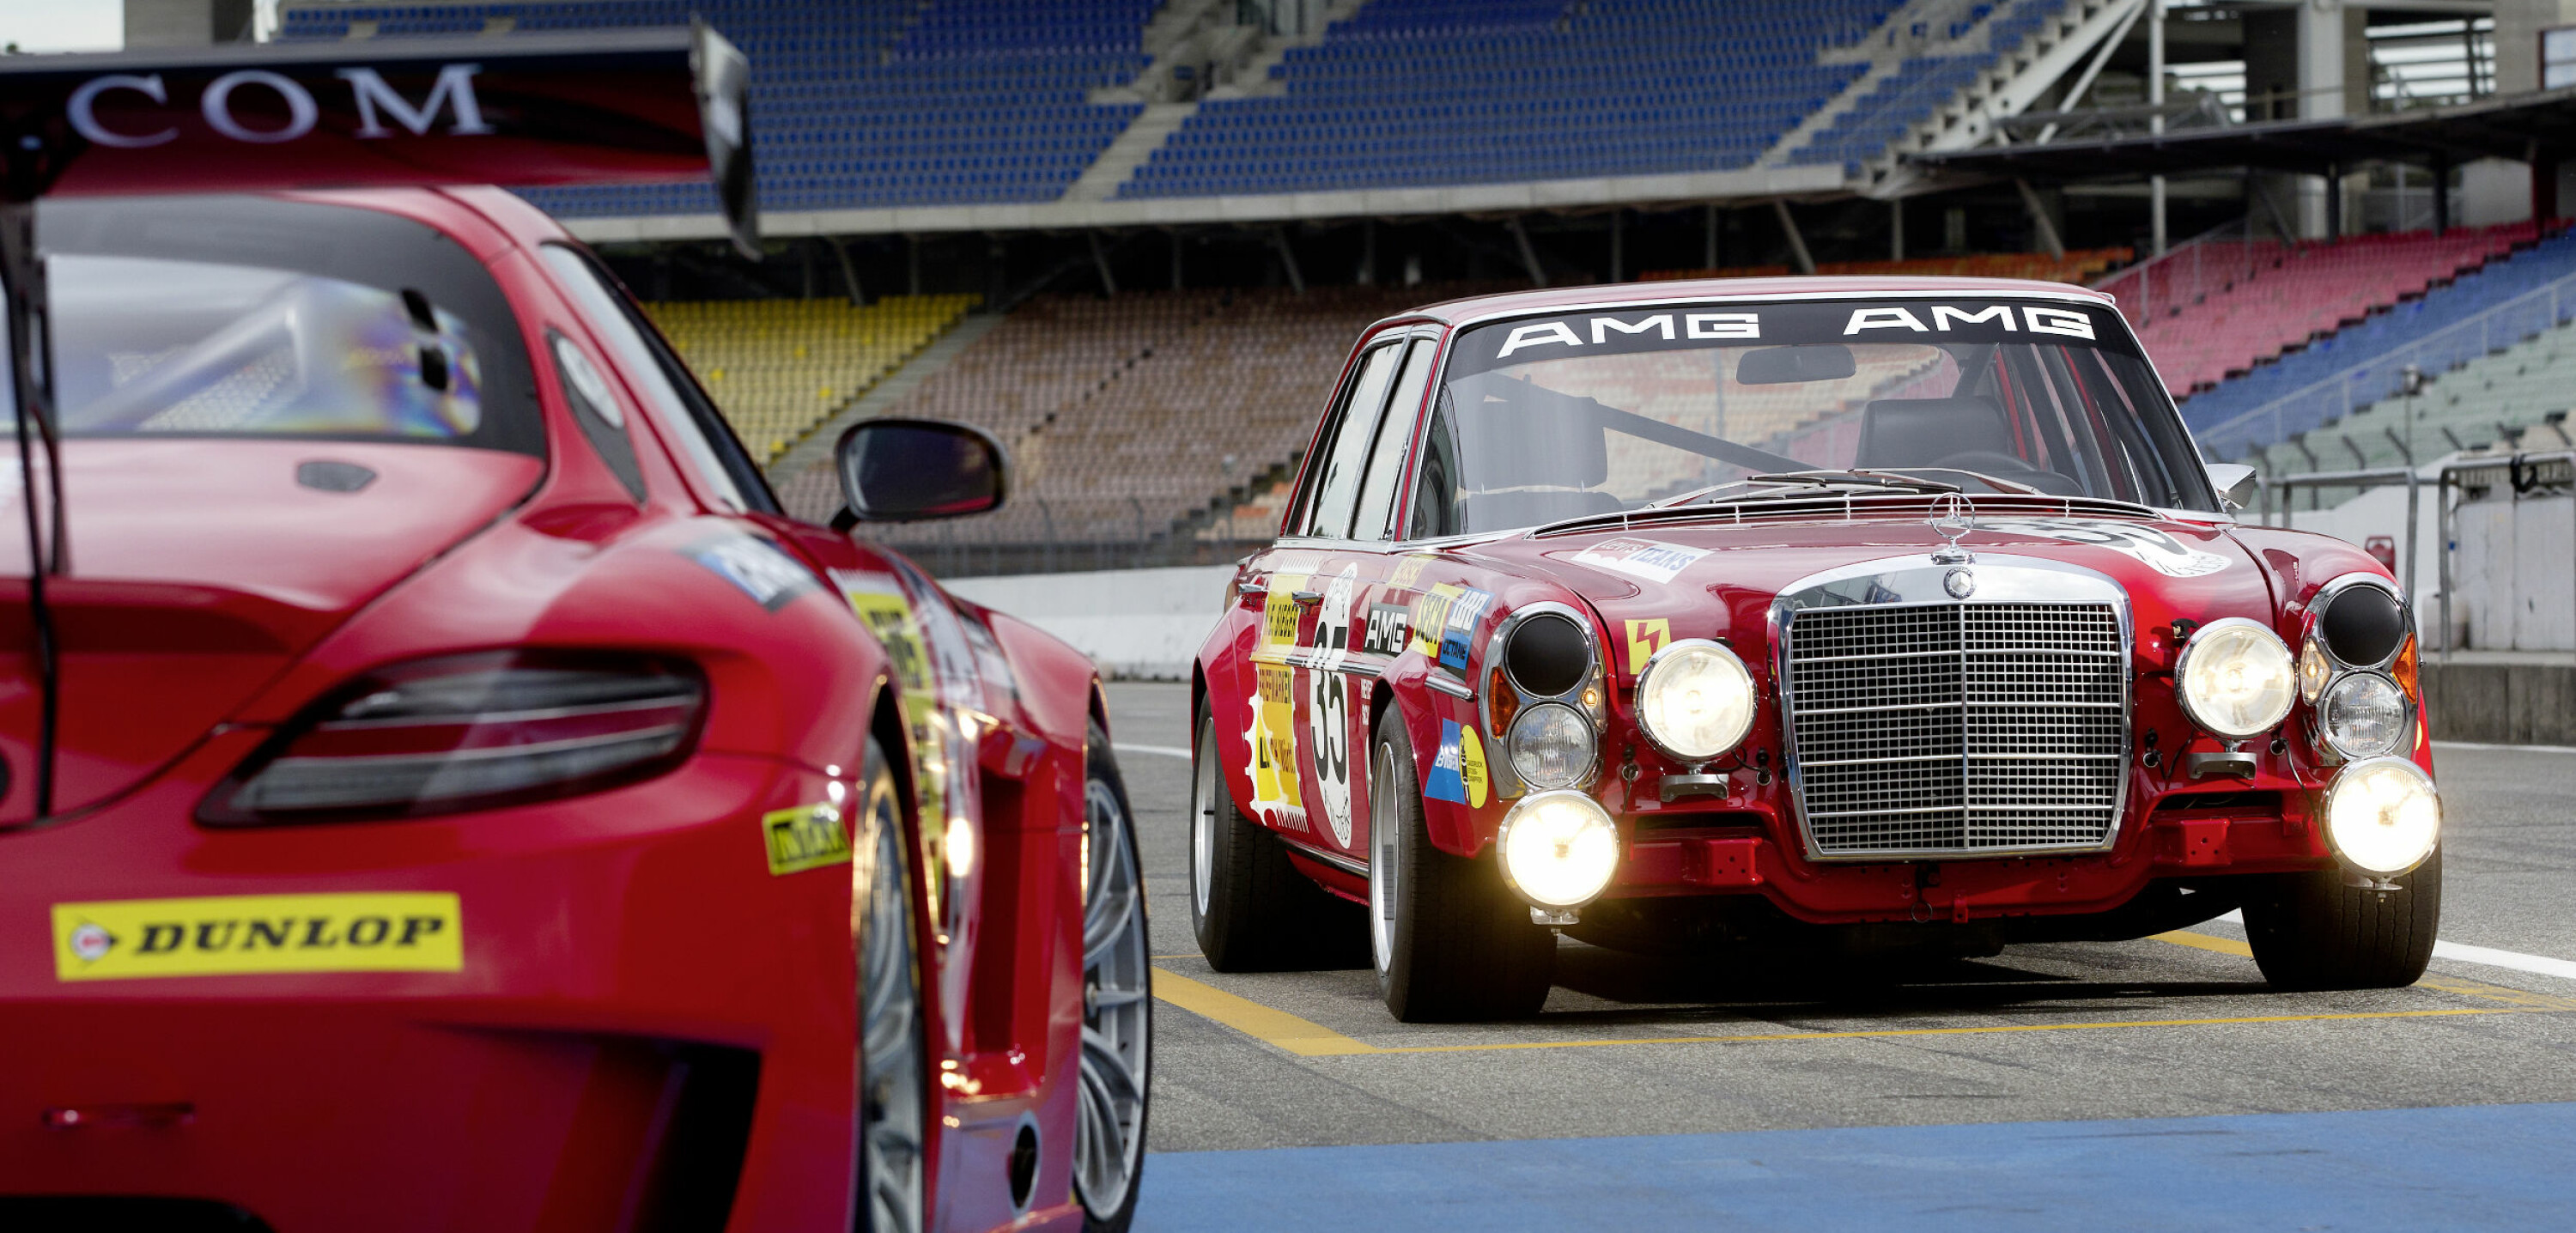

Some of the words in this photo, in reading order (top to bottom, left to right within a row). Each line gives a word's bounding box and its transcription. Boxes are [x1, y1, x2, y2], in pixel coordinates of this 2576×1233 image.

[1497, 313, 1761, 359] AMG
[1843, 305, 2096, 341] AMG
[1629, 546, 1696, 571] JEANS
[1364, 609, 1407, 653] AMG
[1310, 620, 1349, 785] 35
[136, 914, 445, 955] DUNLOP
